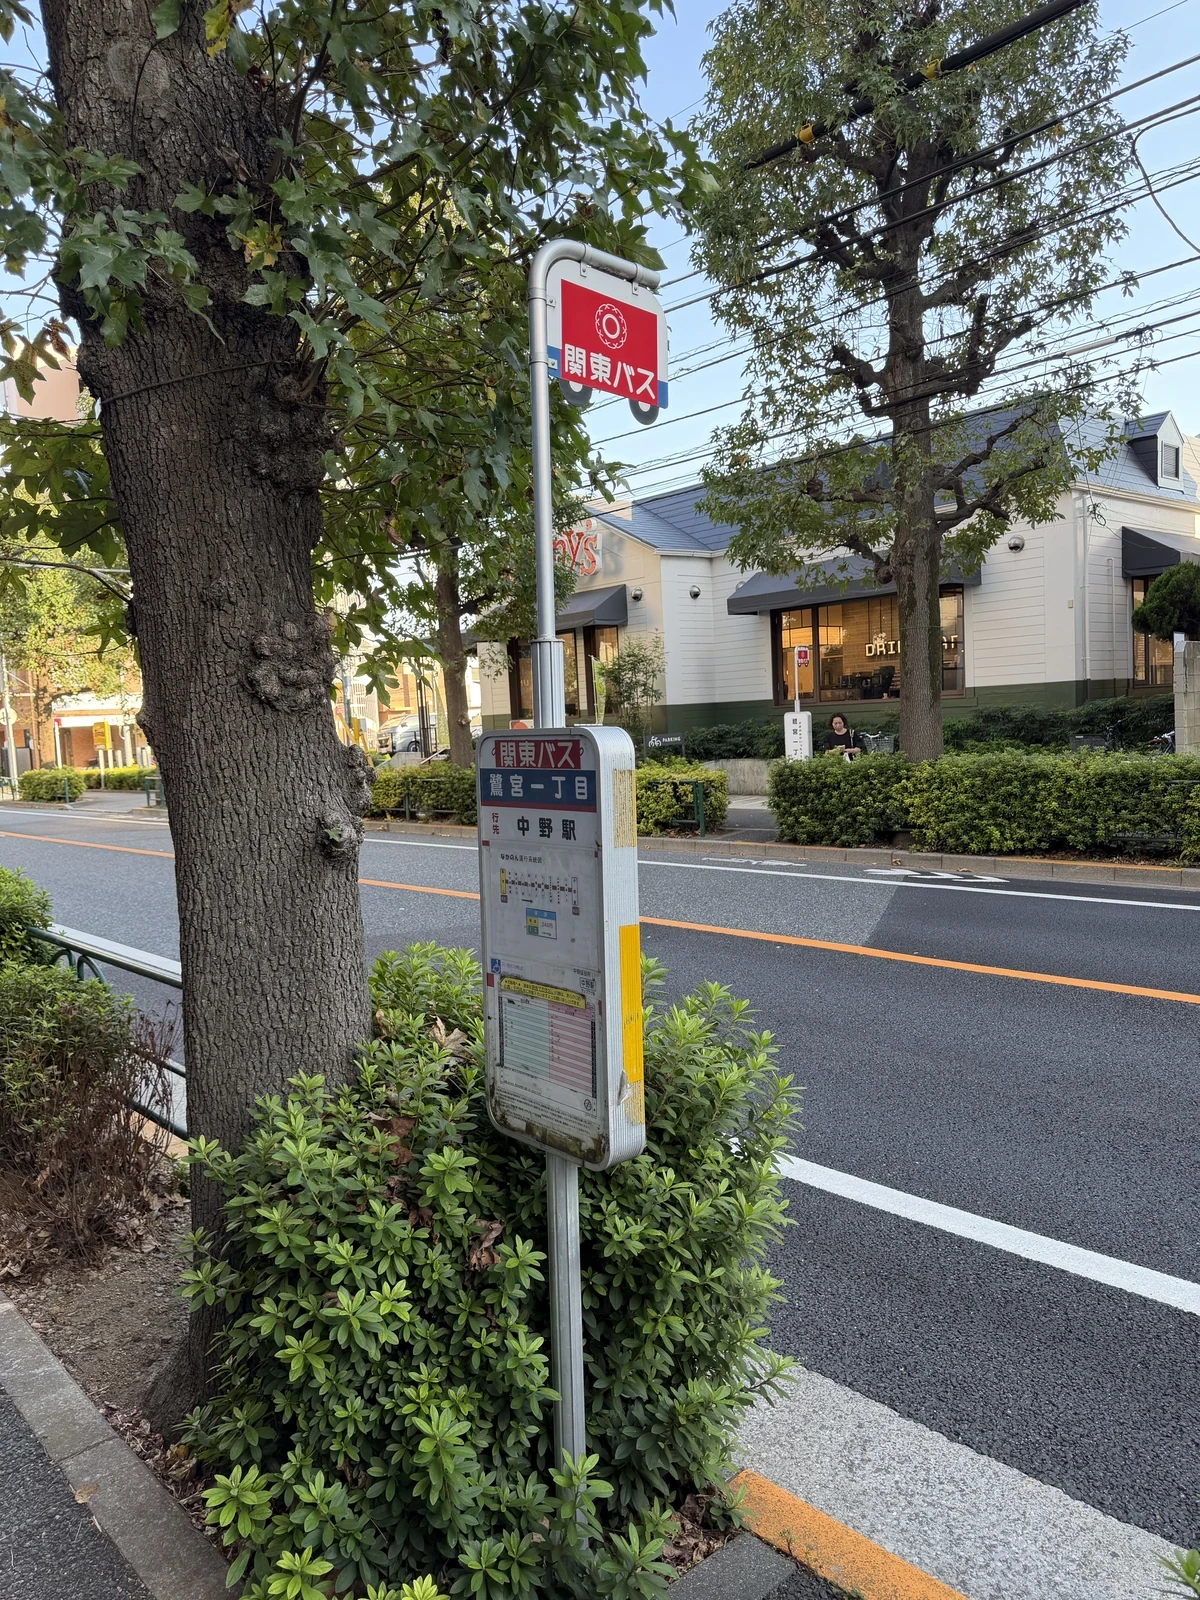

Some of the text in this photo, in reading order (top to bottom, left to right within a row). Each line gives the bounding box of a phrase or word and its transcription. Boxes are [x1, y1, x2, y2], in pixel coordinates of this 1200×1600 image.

[564, 343, 656, 400] 関東バス
[865, 640, 901, 657] DRI
[500, 741, 575, 768] 関東バス
[489, 773, 588, 800] 鷺宮一丁目
[491, 812, 500, 835] 行先
[517, 815, 577, 841] 中野駅
